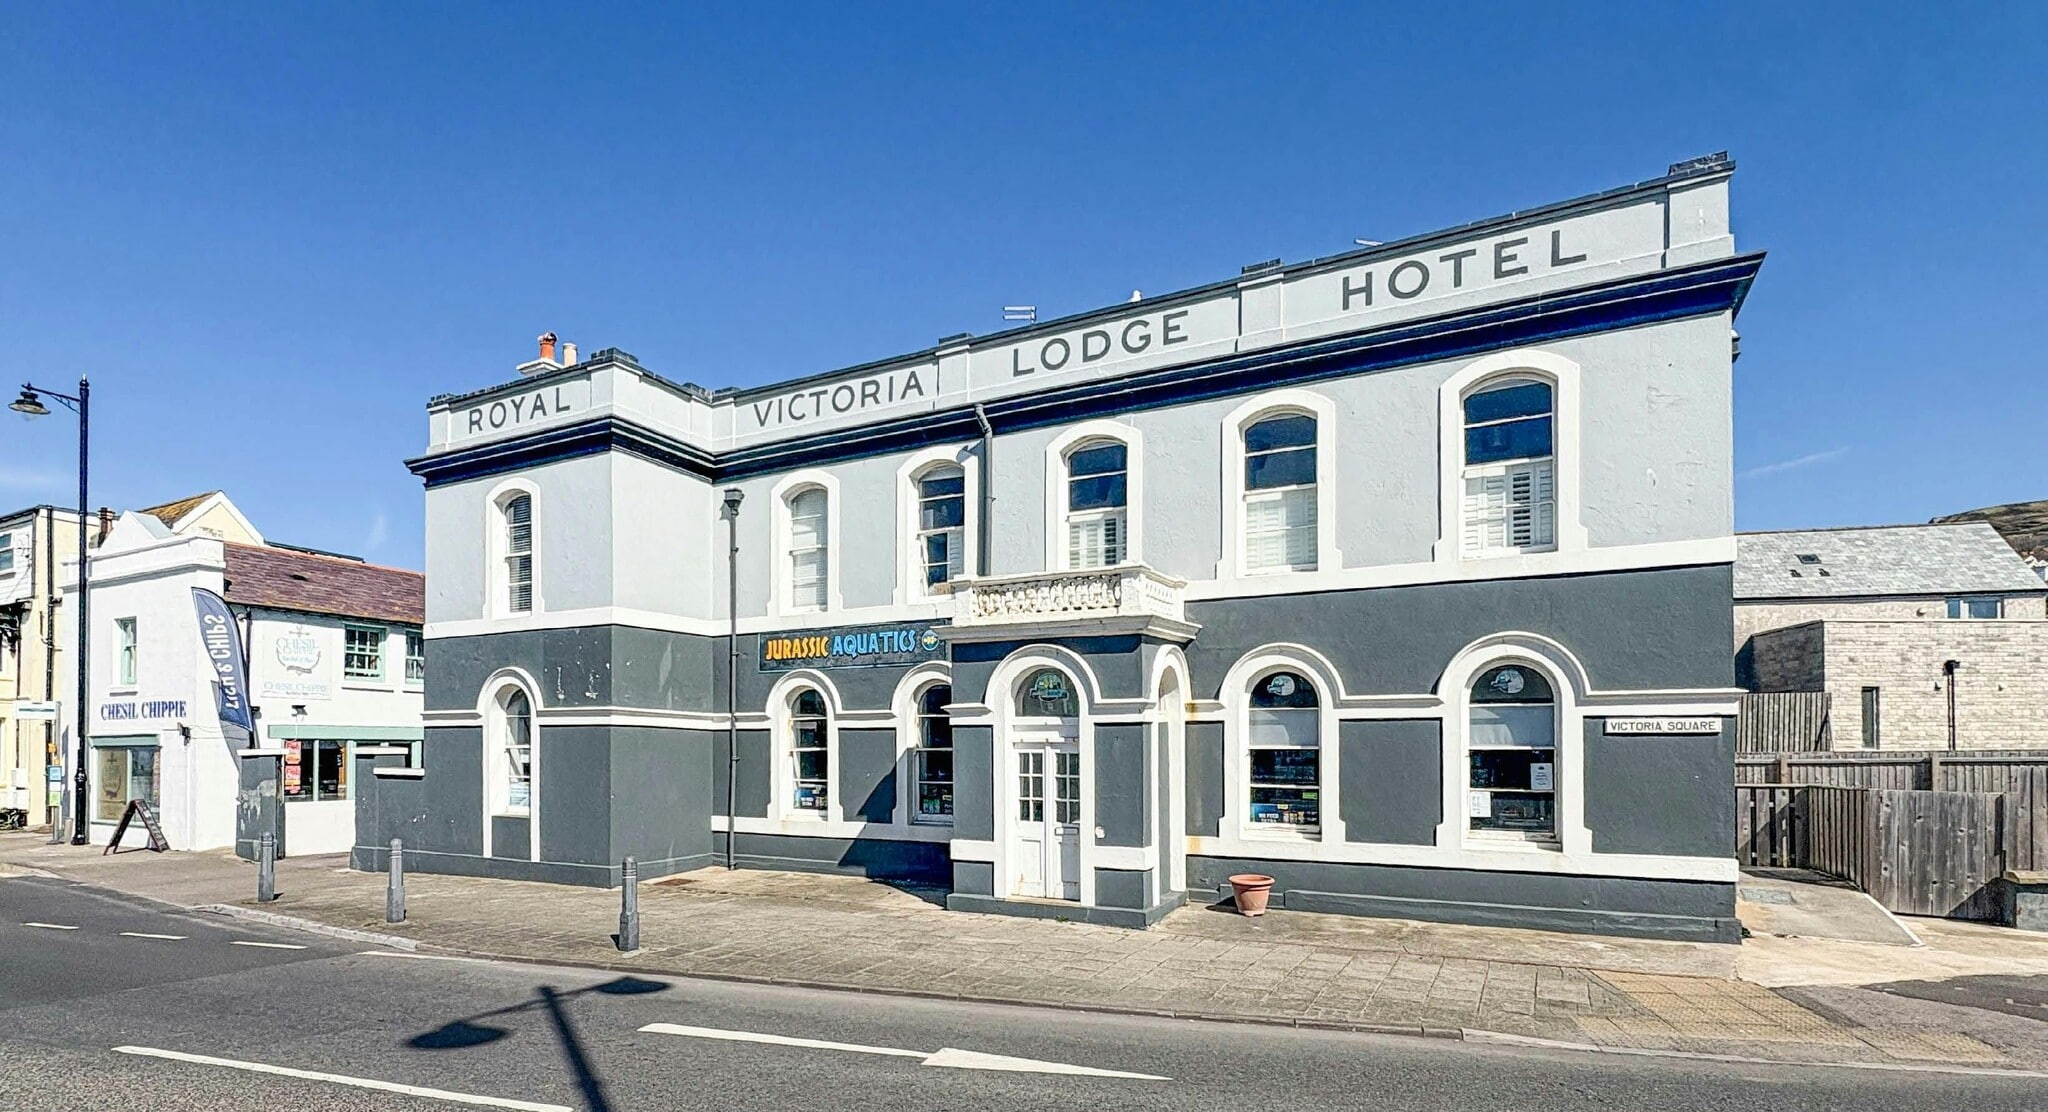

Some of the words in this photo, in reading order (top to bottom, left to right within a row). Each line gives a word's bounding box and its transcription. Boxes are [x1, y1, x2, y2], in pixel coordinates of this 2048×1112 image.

[469, 387, 570, 434] ROYAL
[754, 370, 924, 427] VICTORIA
[1013, 310, 1188, 377] LODGE
[1342, 230, 1587, 311] HOTEL
[765, 636, 829, 661] JURASSIC
[832, 629, 916, 659] AQUATICS
[101, 702, 138, 720] CHESIL
[141, 700, 186, 719] CHIPPIE
[1610, 721, 1662, 732] VICTORIA
[1667, 720, 1716, 731] SQUARE
